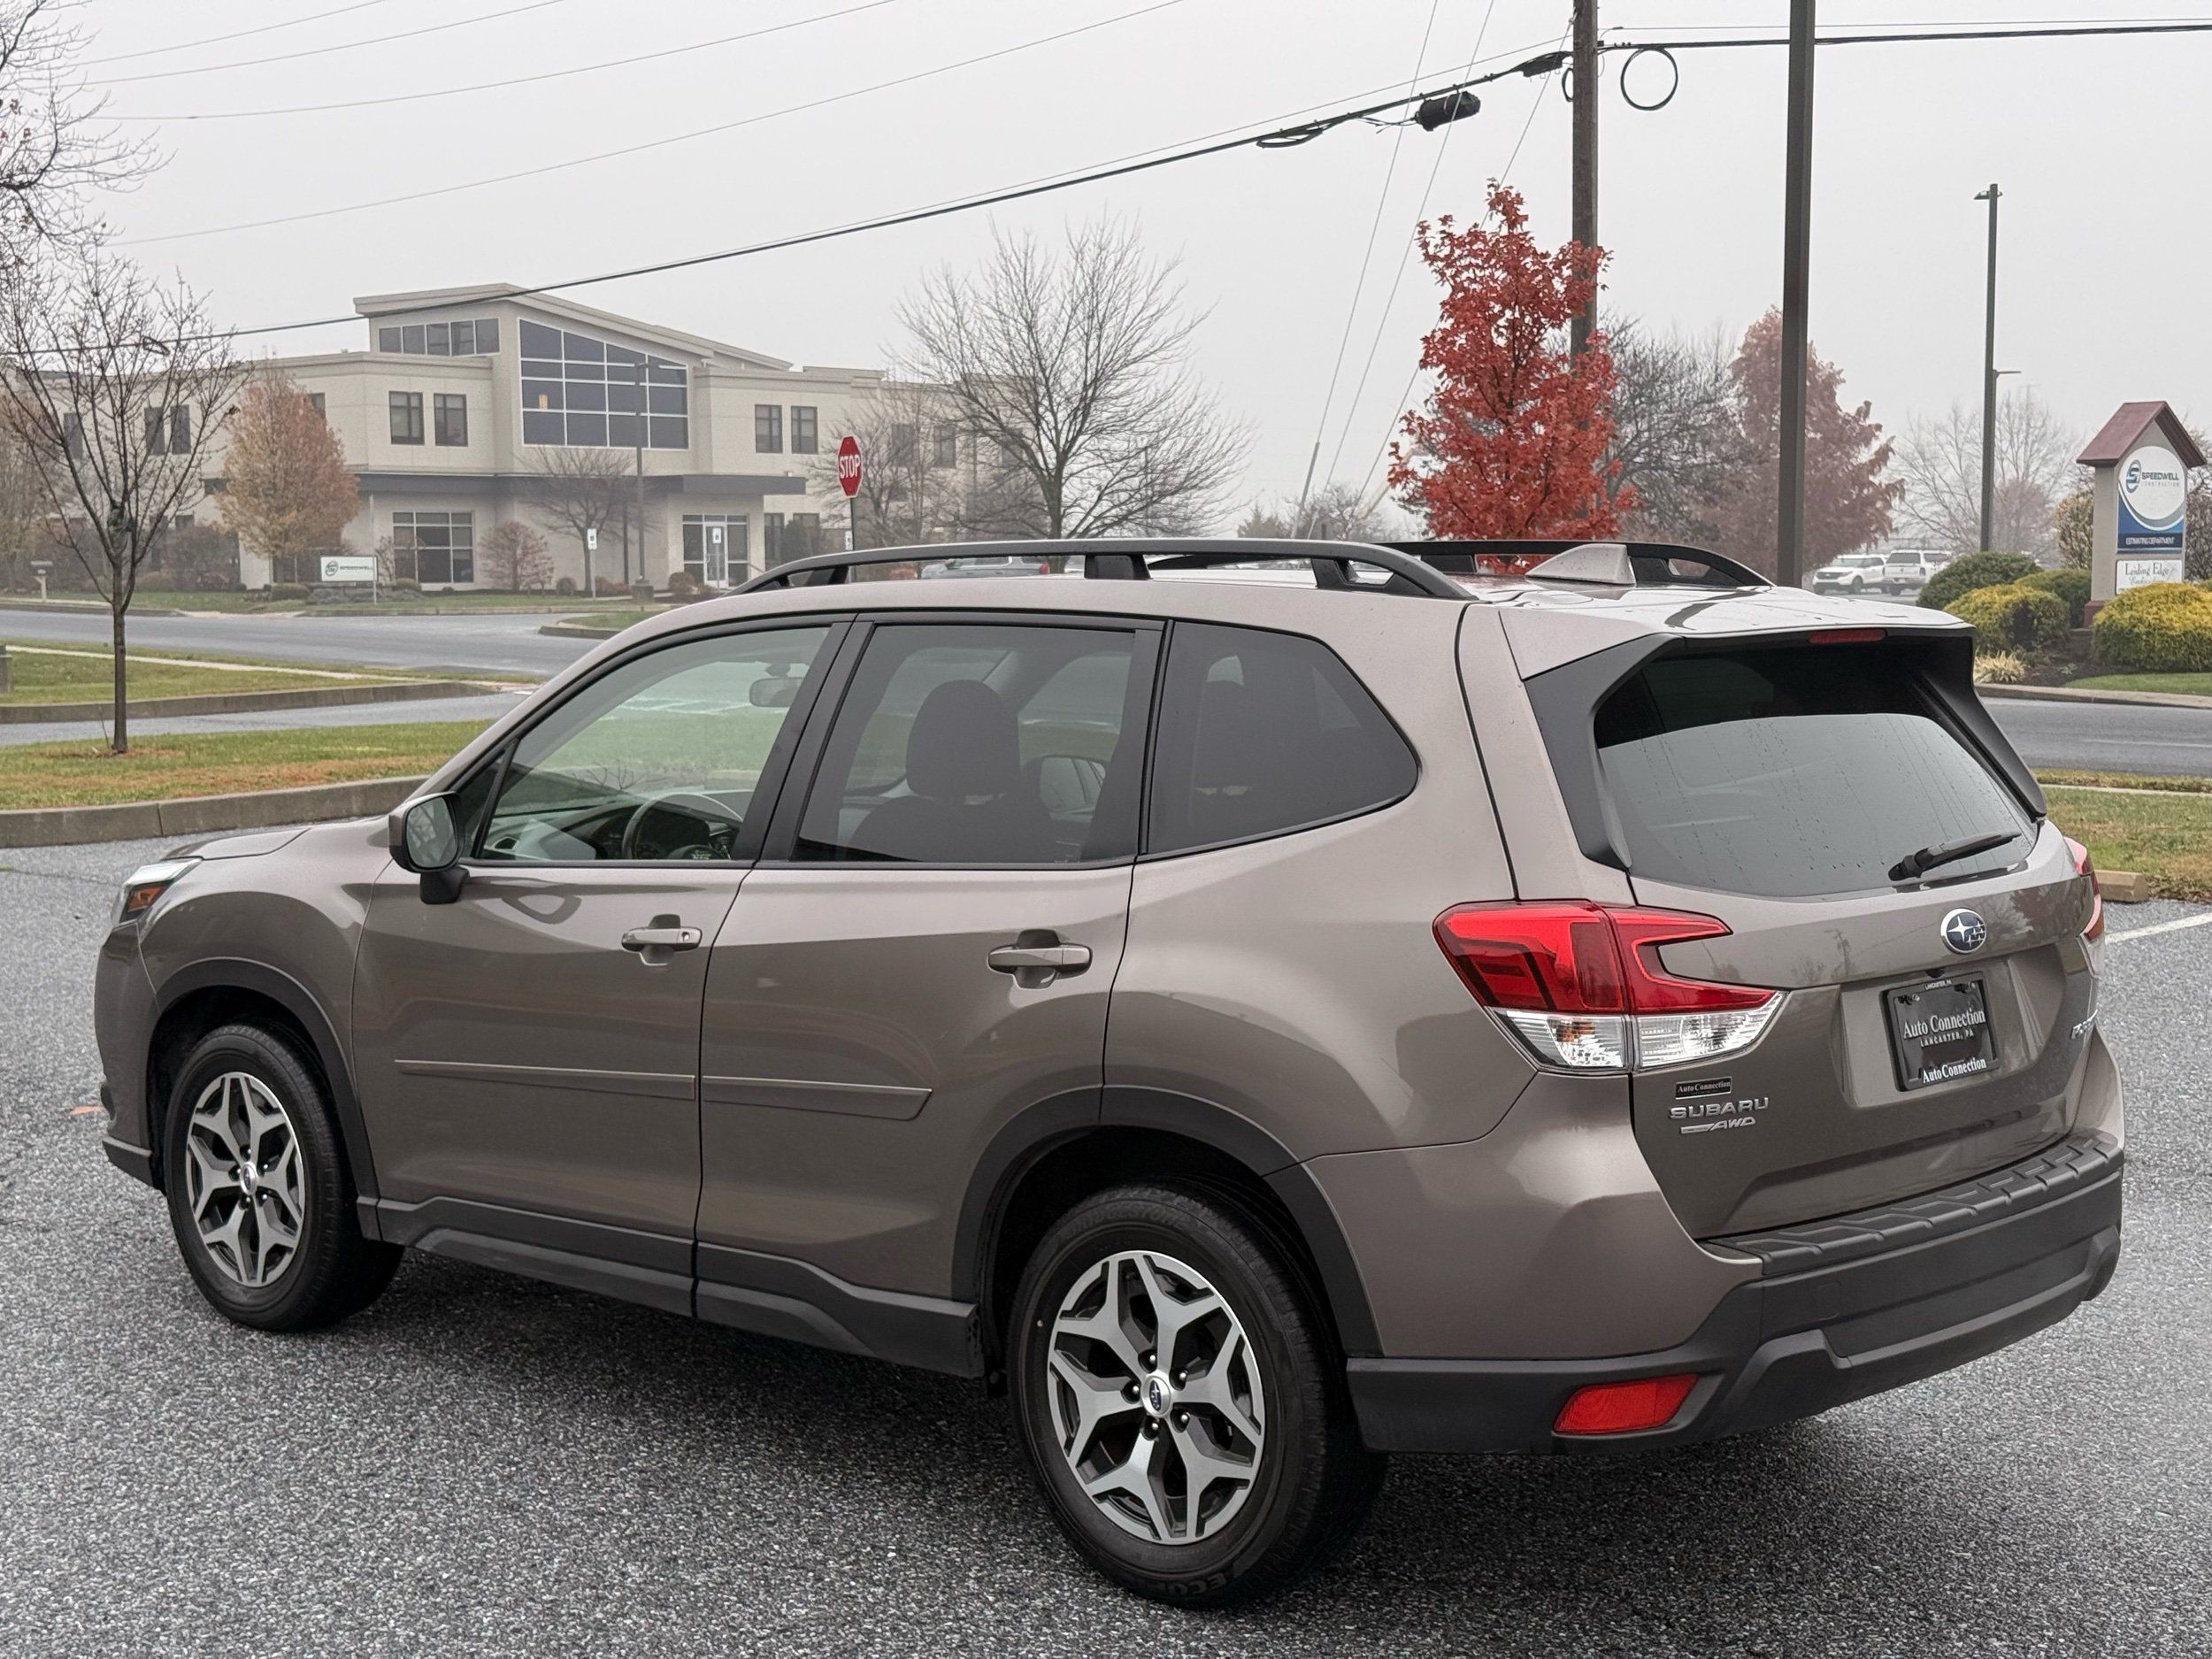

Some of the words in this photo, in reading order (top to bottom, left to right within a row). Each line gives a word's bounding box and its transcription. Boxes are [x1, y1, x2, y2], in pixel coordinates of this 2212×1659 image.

[840, 454, 860, 479] STOP
[2141, 472, 2179, 481] SPEEDWELL
[2124, 563, 2150, 575] Leading
[2153, 562, 2169, 576] Edge
[1903, 1020, 1929, 1039] Auto
[1930, 1007, 1986, 1033] Connection
[1965, 1028, 1974, 1038] PA
[1923, 1069, 1942, 1084] Auto
[1942, 1057, 1986, 1078] Connection
[1694, 1080, 1731, 1091] Connection
[1670, 1097, 1770, 1119] SUBARU
[1709, 1116, 1756, 1132] AWD
